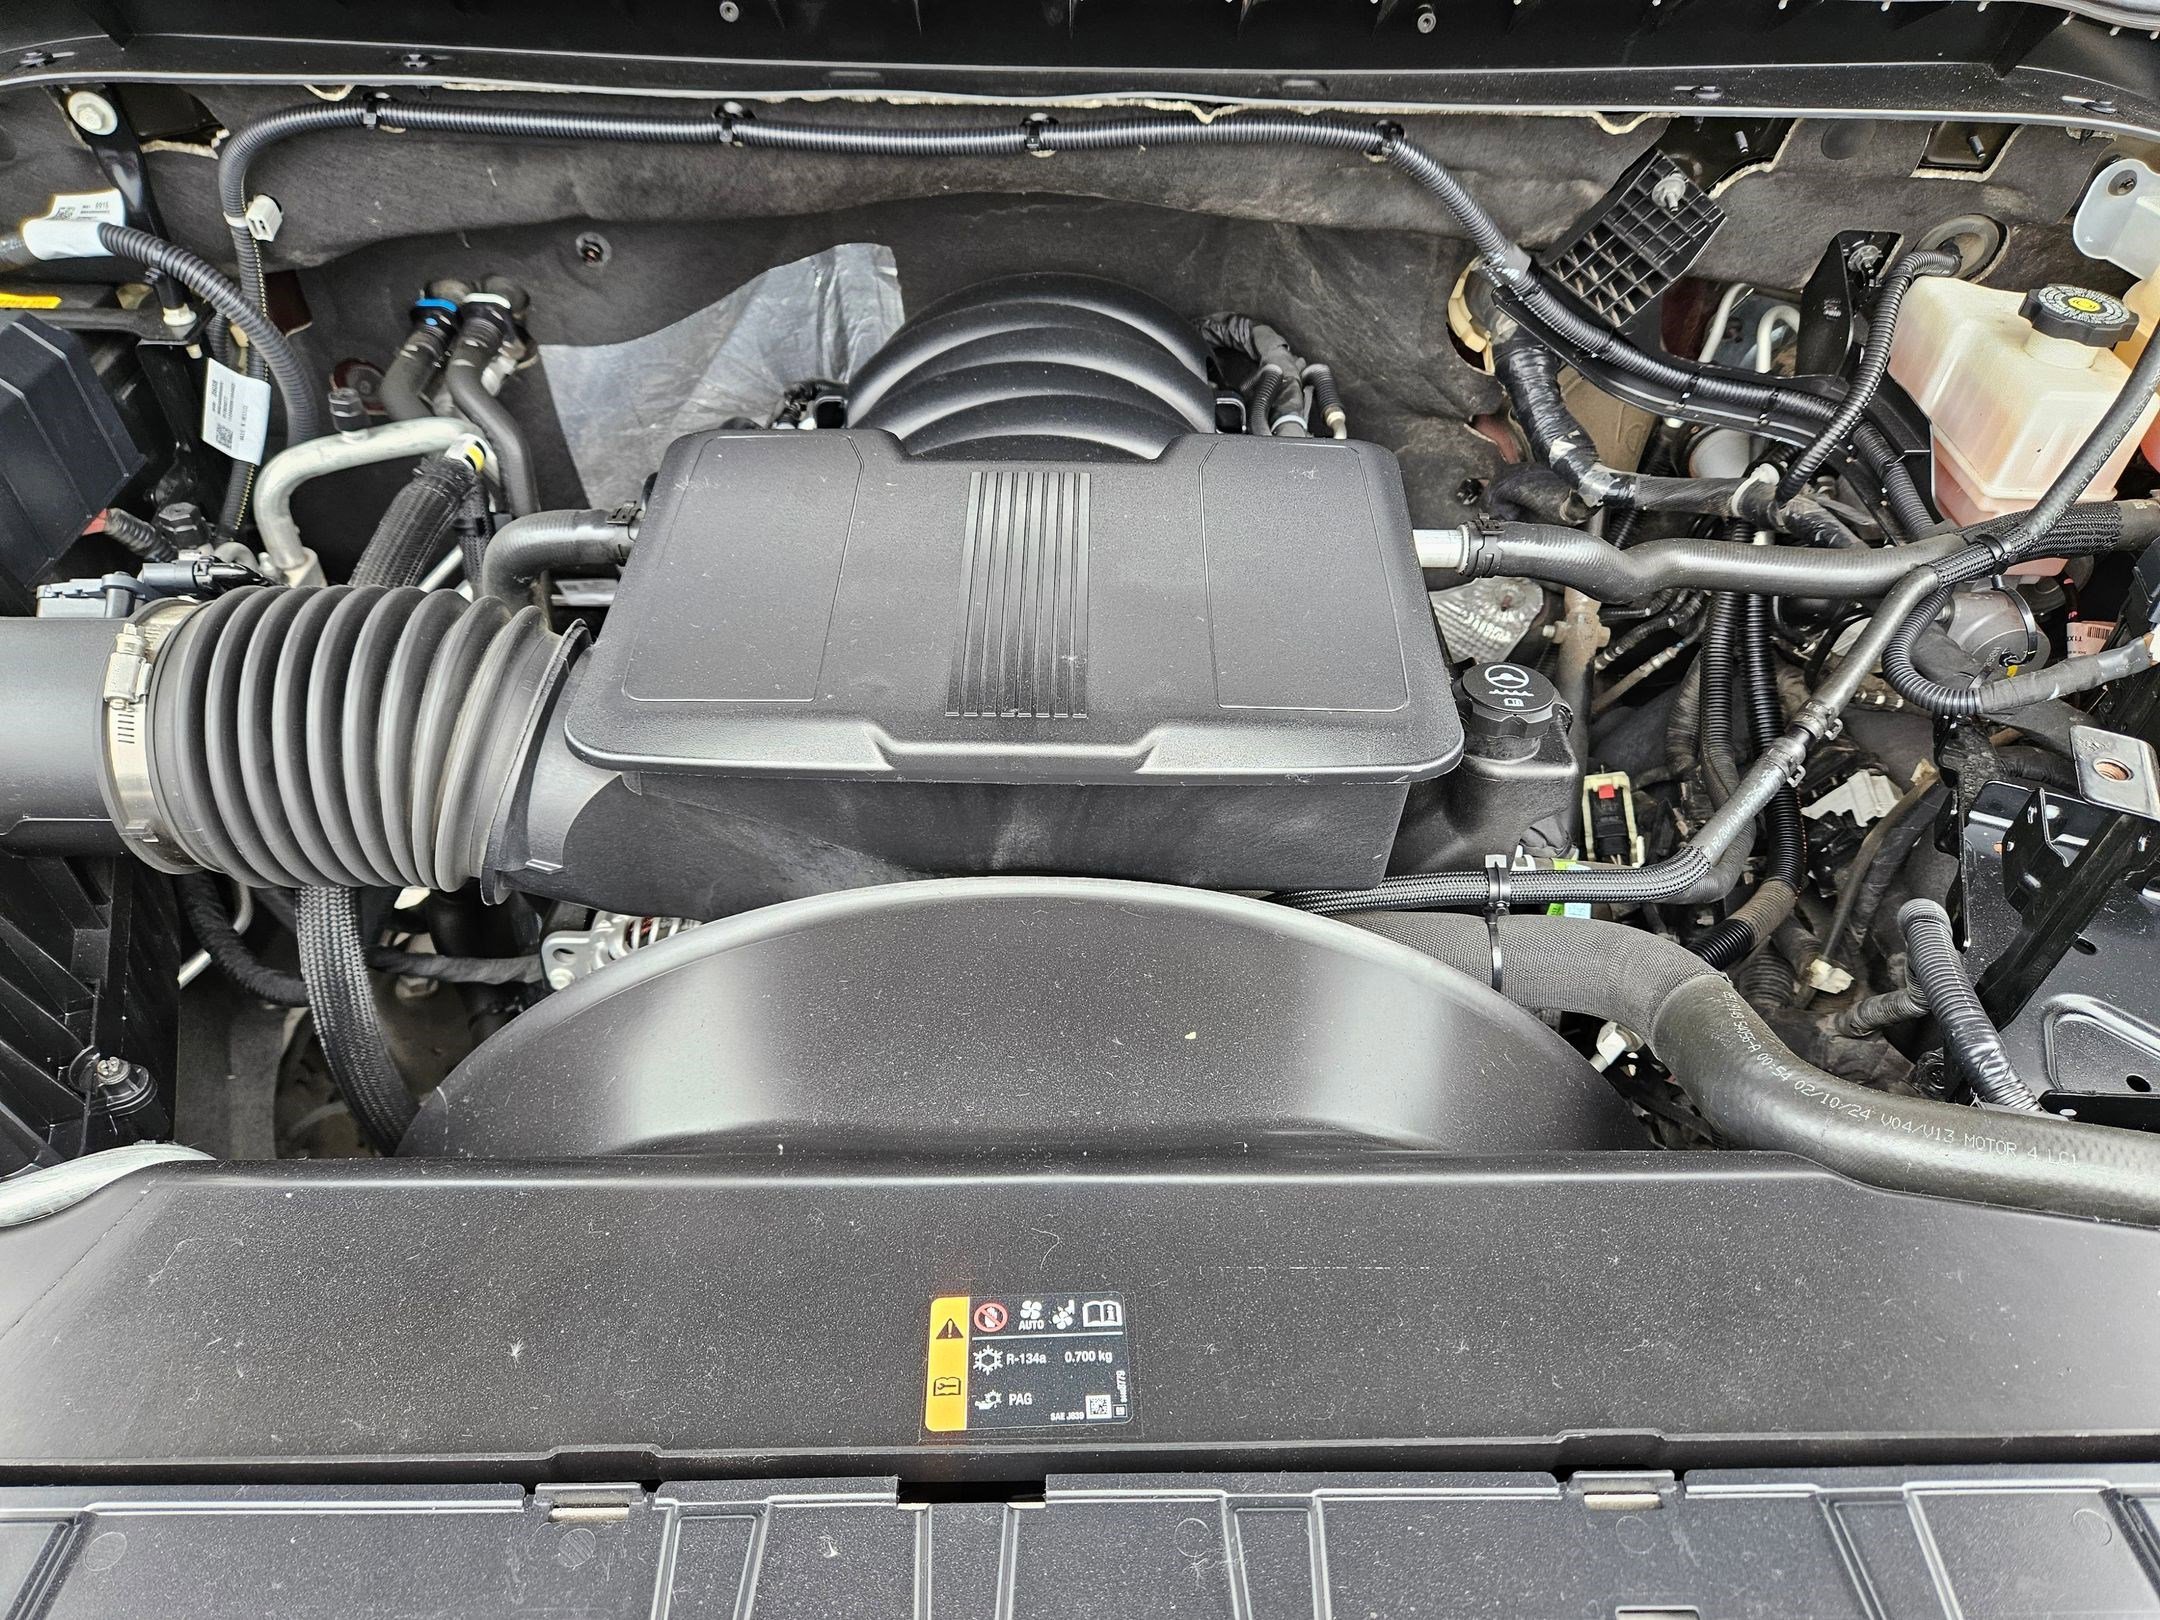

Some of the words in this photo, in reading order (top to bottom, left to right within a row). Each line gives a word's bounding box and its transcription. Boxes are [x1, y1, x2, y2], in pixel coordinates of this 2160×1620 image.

[2089, 433, 2122, 475] 02/02/24
[1793, 1078, 1872, 1122] 02/10/24
[1880, 1113, 1954, 1144] V04/V13
[1964, 1132, 2018, 1158] MOTOR
[1018, 1319, 1045, 1331] AUTO
[1006, 1351, 1047, 1365] R-134a
[1064, 1350, 1096, 1364] 0.700
[1098, 1350, 1113, 1364] kg
[1008, 1392, 1033, 1406] PAG
[1050, 1411, 1066, 1422] SAE
